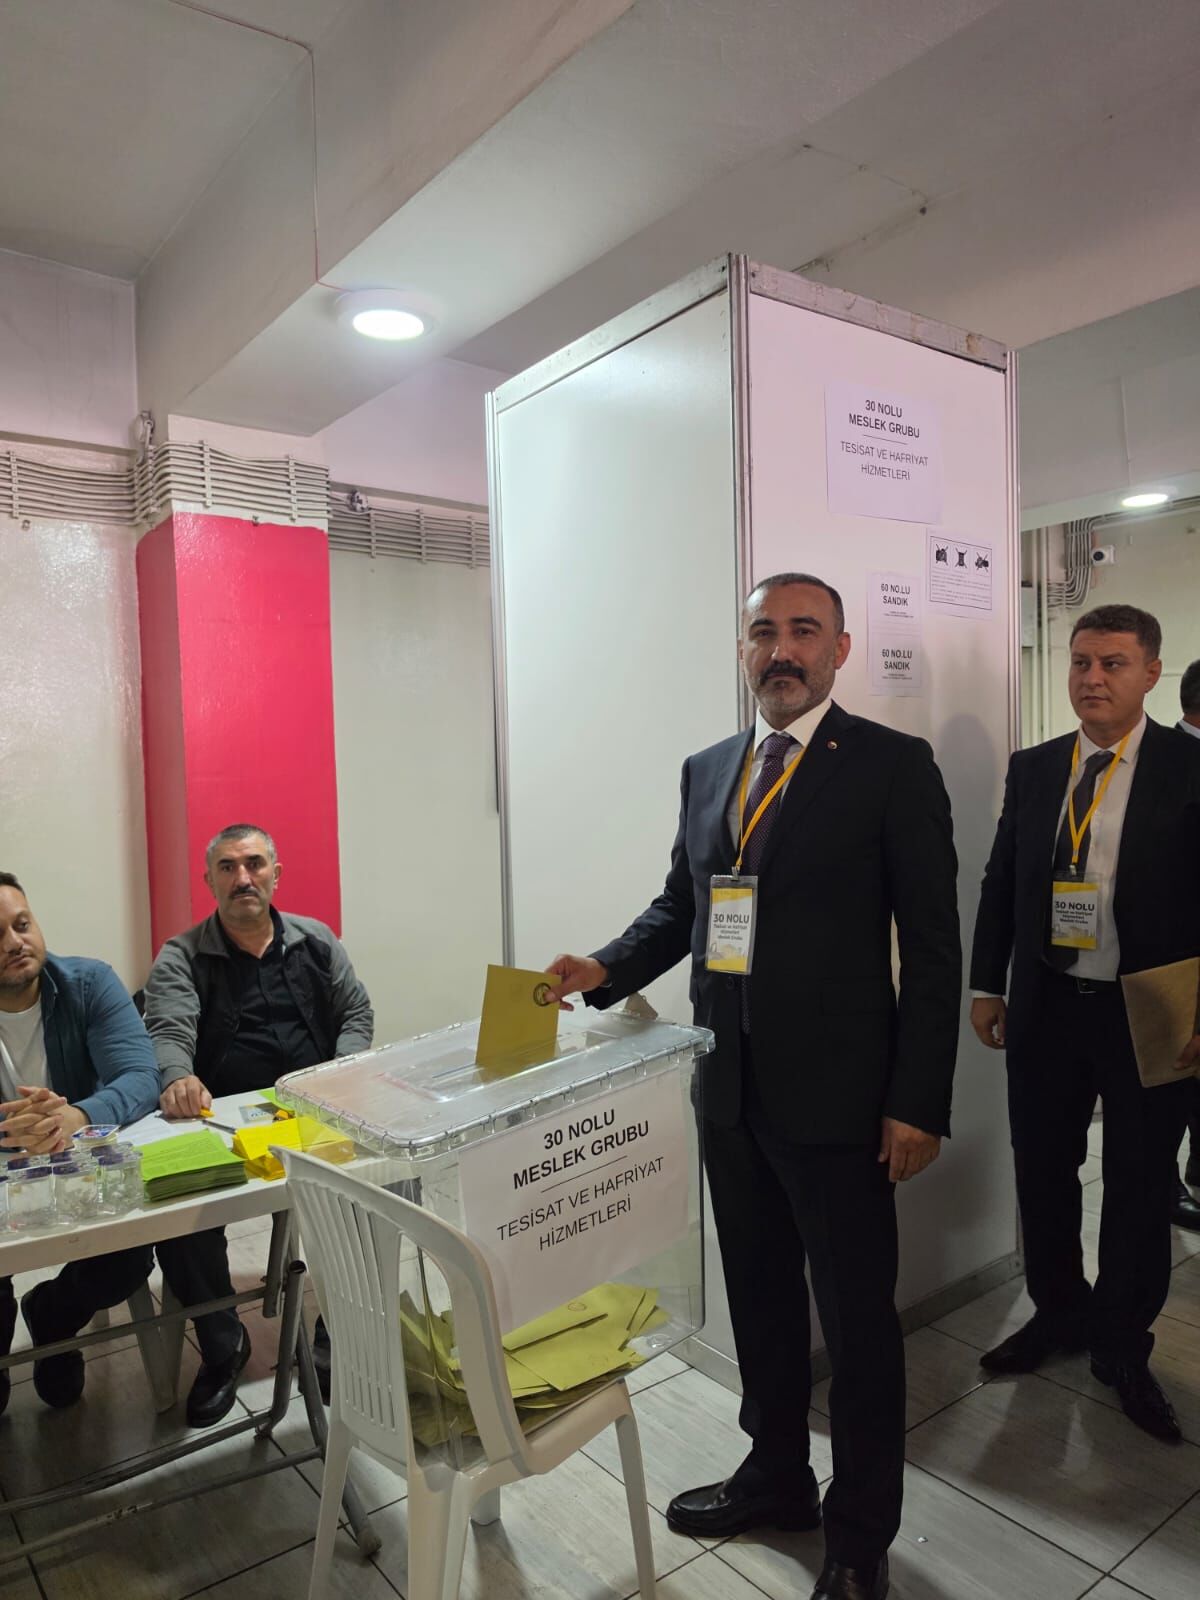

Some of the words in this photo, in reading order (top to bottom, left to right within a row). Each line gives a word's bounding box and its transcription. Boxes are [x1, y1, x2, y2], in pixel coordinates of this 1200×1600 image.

[865, 400, 875, 411] 30
[878, 403, 902, 417] NOLU
[849, 413, 886, 431] MESLEK
[889, 422, 919, 438] GRUBU
[840, 441, 874, 457] TESİSAT
[877, 448, 887, 459] VE
[889, 451, 928, 466] HAFRİYAT
[861, 464, 910, 480] HİZMETLERİ
[881, 584, 888, 592] 60
[882, 595, 908, 606] SANDIK
[882, 649, 889, 657] 60
[884, 661, 910, 670] SANDIK
[1055, 901, 1066, 909] 30
[1068, 902, 1095, 911] NOLU
[713, 914, 724, 923] 30
[726, 913, 750, 924] NOLU
[543, 1129, 563, 1150] 30
[568, 1109, 615, 1140] NOLU
[513, 1145, 586, 1190] MESLEK
[591, 1120, 649, 1156] GRUBU
[497, 1199, 565, 1240] TESİSAT
[568, 1188, 590, 1208] VE
[594, 1157, 664, 1199] HAFRİYAT
[539, 1194, 631, 1251] HİZMETLERİ
